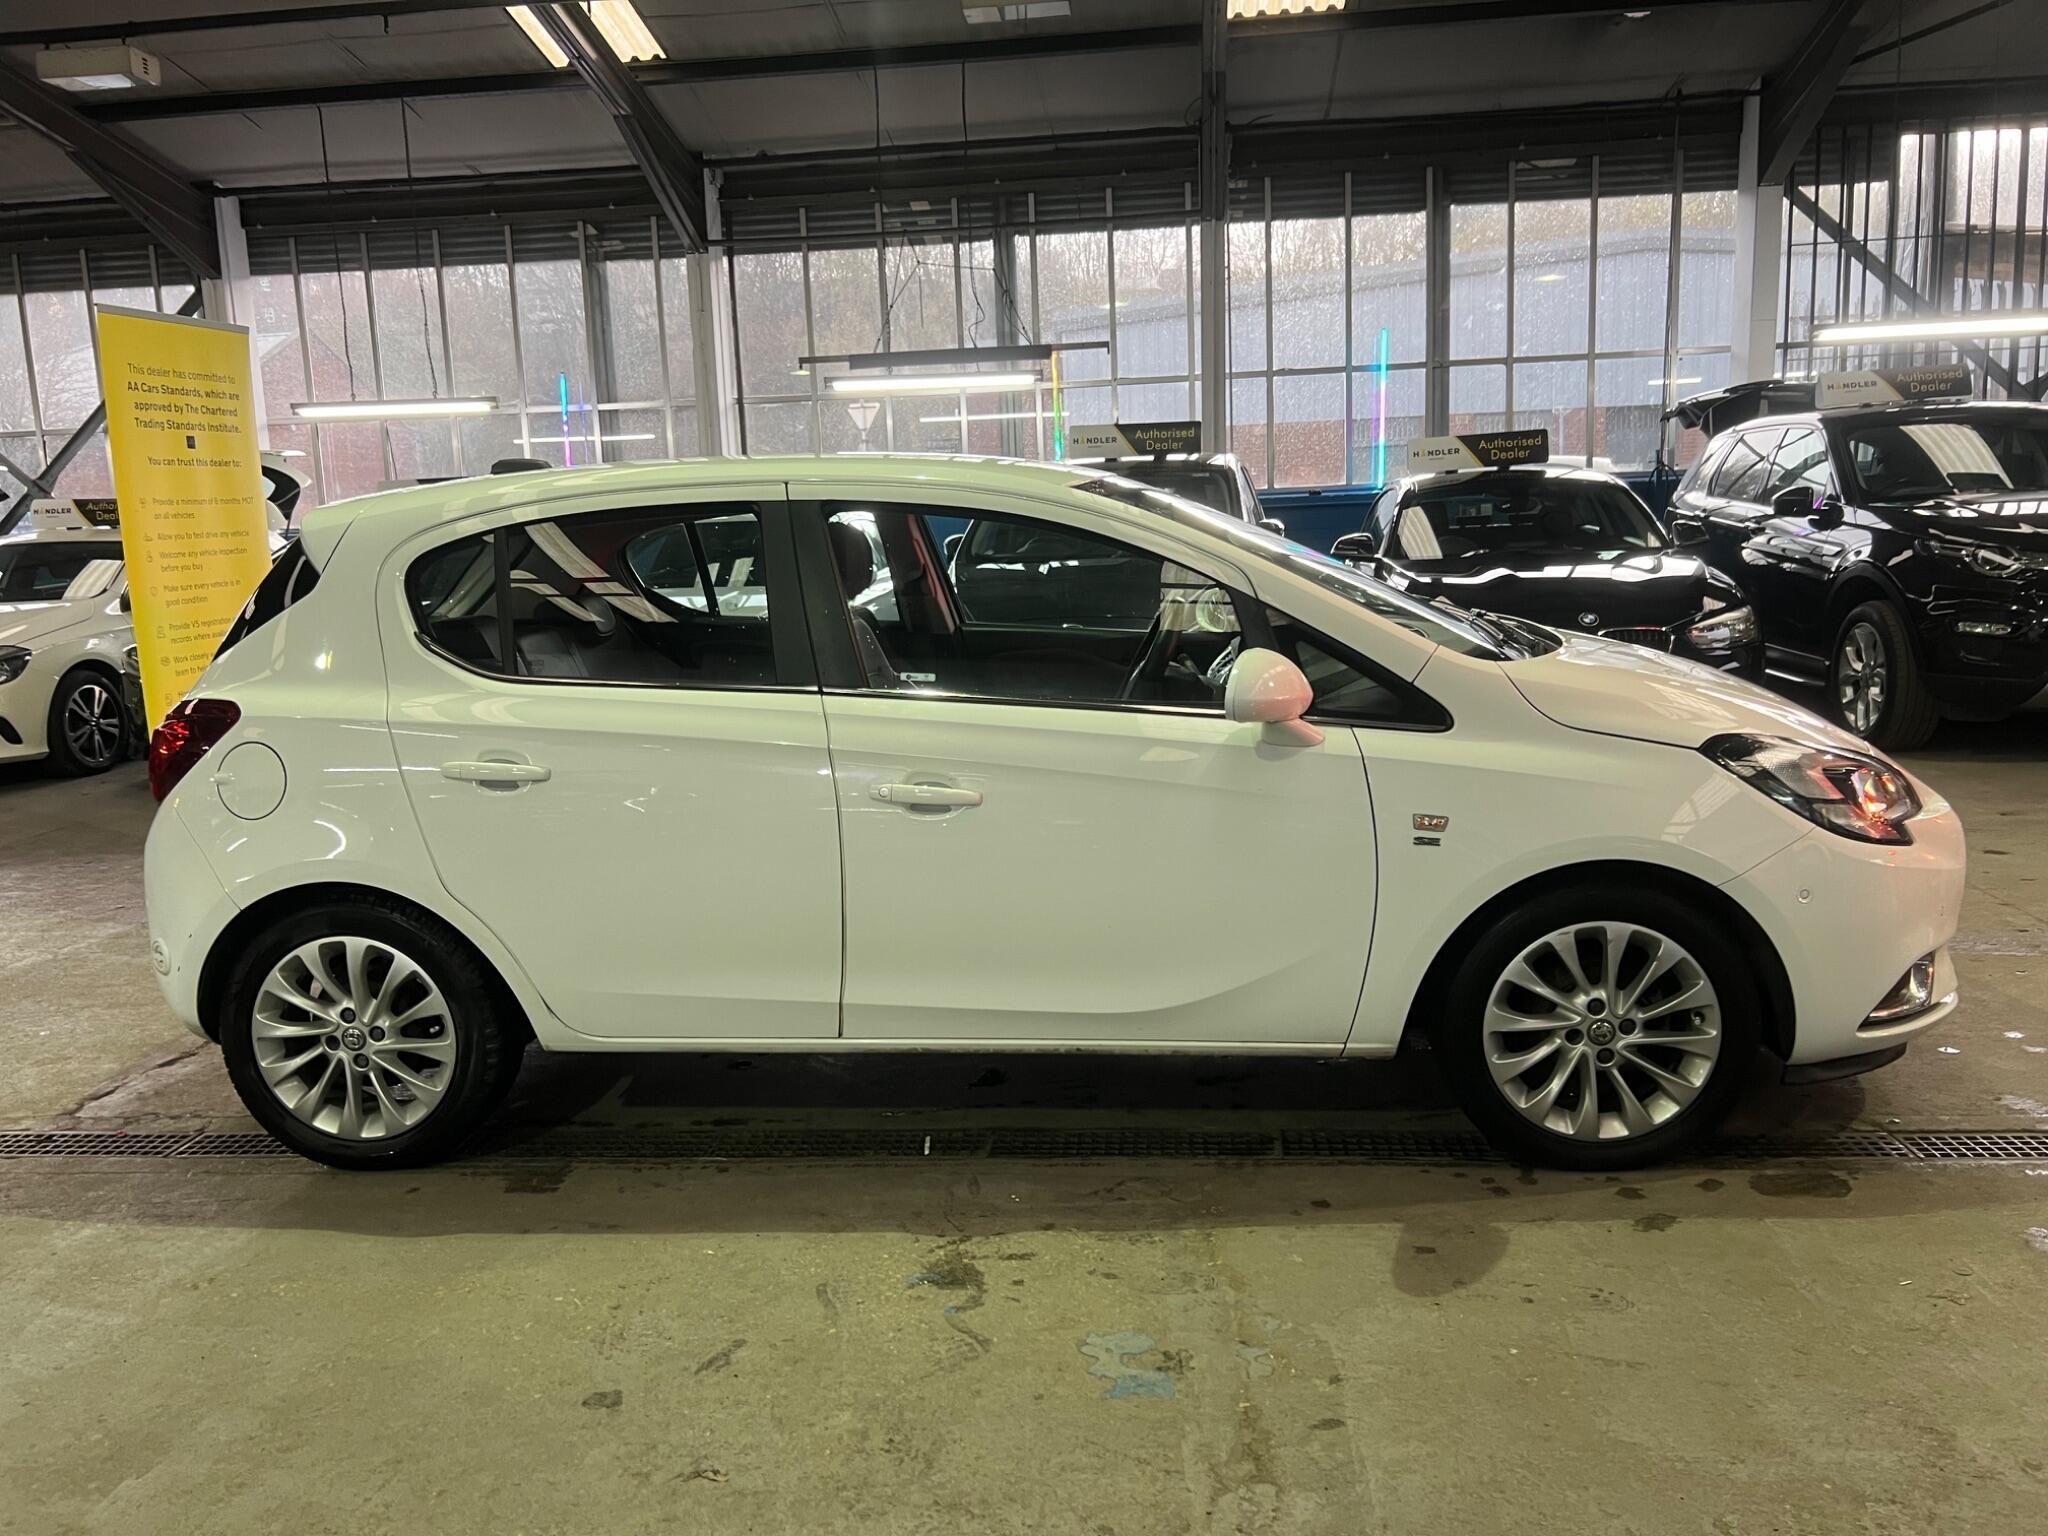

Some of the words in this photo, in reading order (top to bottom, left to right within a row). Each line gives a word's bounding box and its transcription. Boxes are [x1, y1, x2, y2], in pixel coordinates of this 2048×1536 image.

[128, 363, 145, 375] This
[146, 366, 170, 378] dealer
[172, 368, 187, 380] has
[188, 370, 227, 383] committed
[227, 375, 236, 384] to
[1897, 369, 1963, 382] Authorised
[127, 381, 139, 392] AA
[140, 383, 159, 394] Cars
[161, 384, 204, 399] Standards,
[205, 389, 227, 399] which
[228, 392, 240, 401] are
[1910, 382, 1952, 392] Dealer
[134, 401, 172, 413] approved
[174, 403, 183, 416] by
[185, 403, 199, 414] The
[200, 405, 238, 417] Chartered
[134, 417, 165, 431] Trading
[167, 419, 206, 432] Standards
[207, 422, 242, 434] Institute.
[1135, 427, 1195, 440] Authorised
[1146, 440, 1183, 450] Dealer
[1478, 435, 1542, 450] Authorised
[1491, 449, 1530, 460] Dealer
[147, 456, 161, 466] You
[163, 458, 175, 466] can
[177, 457, 195, 466] trust
[196, 458, 208, 467] this
[209, 458, 231, 467] dealer
[86, 501, 118, 511] Author
[96, 511, 119, 520] Deal
